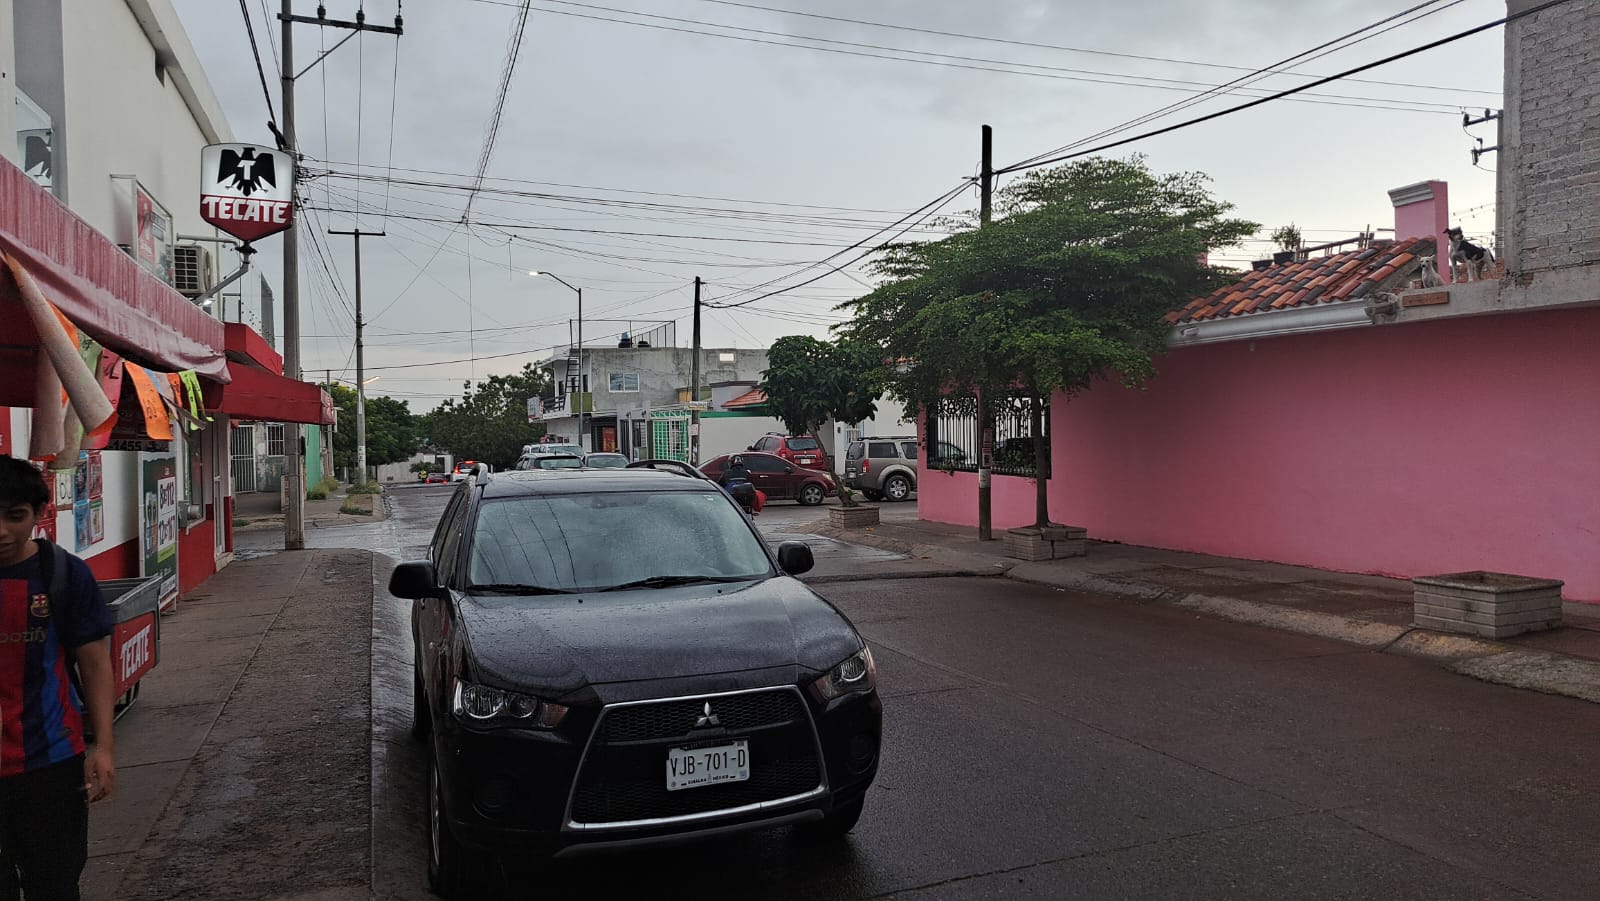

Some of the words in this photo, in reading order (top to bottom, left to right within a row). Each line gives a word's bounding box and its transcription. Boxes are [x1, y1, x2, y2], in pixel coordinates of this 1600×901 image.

[237, 159, 256, 181] T
[201, 196, 289, 224] TECATE
[119, 623, 152, 682] TECATE
[670, 749, 745, 776] VJB-701-D
